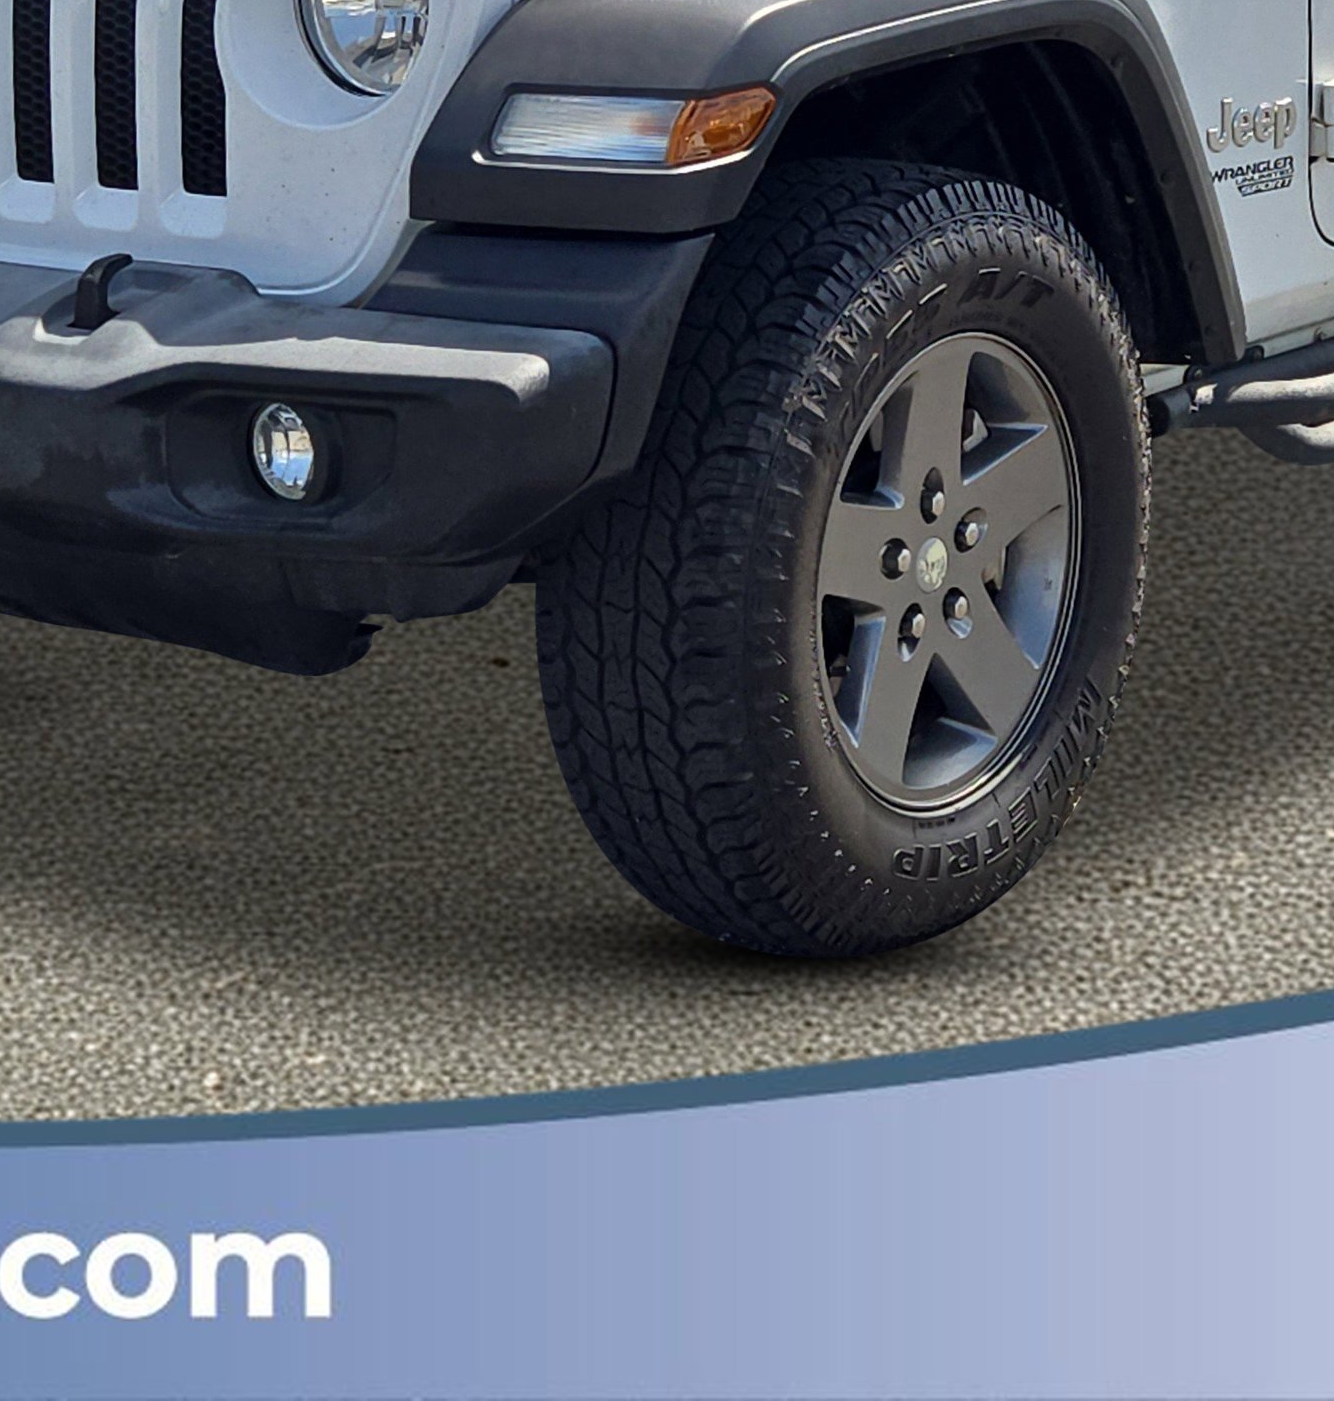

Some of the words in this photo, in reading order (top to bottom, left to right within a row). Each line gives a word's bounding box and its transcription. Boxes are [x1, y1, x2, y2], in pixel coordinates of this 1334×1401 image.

[1206, 97, 1297, 153] Jeep
[1211, 155, 1294, 183] WRANGLER
[1240, 178, 1291, 196] SPORT
[958, 266, 1055, 310] A/T
[893, 676, 1101, 881] MILETRIP
